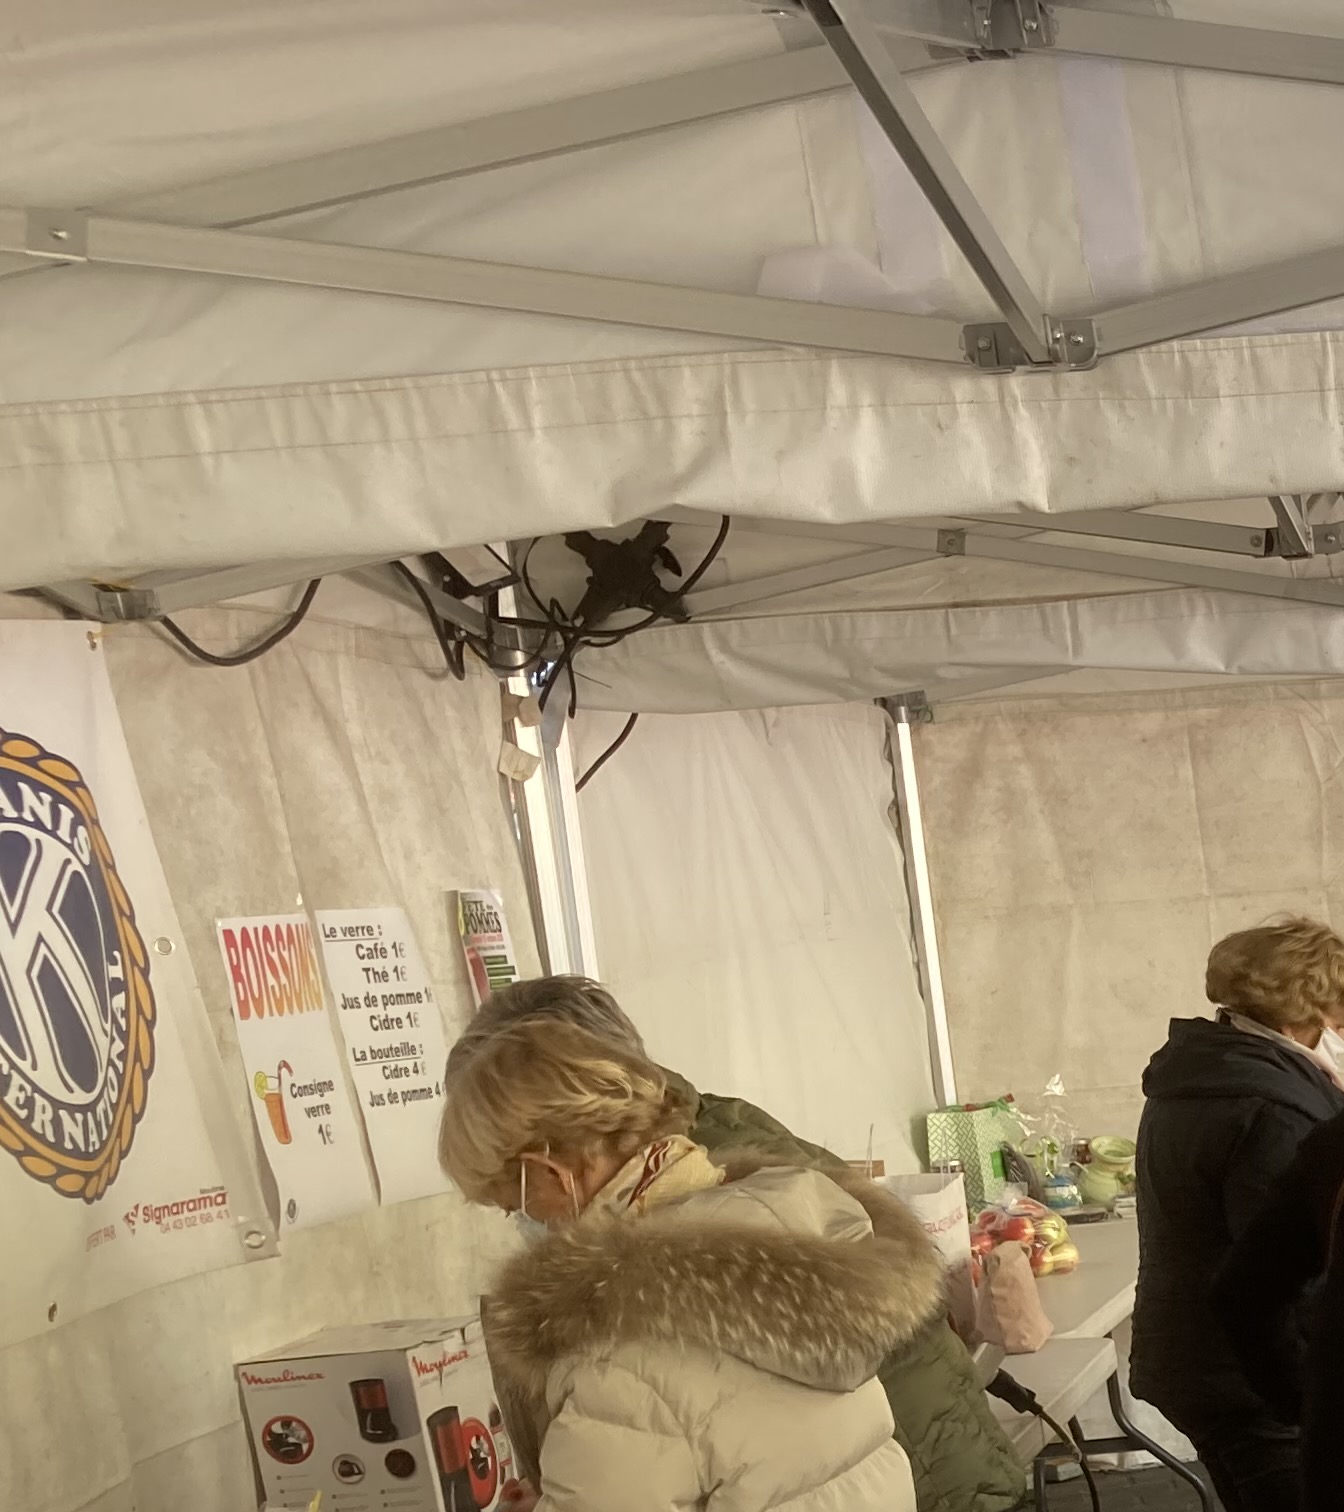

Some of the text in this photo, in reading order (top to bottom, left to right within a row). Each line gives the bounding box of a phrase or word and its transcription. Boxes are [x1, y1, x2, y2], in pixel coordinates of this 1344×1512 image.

[322, 923, 337, 939] Le
[340, 924, 374, 938] verre
[356, 941, 406, 961] Café 1€
[222, 922, 323, 1021] BOISSONS
[362, 965, 408, 984] Thé 1€
[341, 992, 361, 1010] Jus
[364, 991, 379, 1008] de
[382, 991, 423, 1012] pomme
[369, 1011, 420, 1031] Cidre 1€
[352, 1046, 367, 1062] La
[370, 1042, 417, 1060] bouteille
[381, 1063, 410, 1080] Cidre
[412, 1061, 419, 1076] 4
[290, 1079, 335, 1099] Consigne
[368, 1090, 385, 1107] Jus
[387, 1089, 399, 1104] de
[401, 1085, 434, 1107] pomme
[435, 1081, 442, 1097] 4
[304, 1103, 332, 1119] verre
[318, 1123, 334, 1145] 1€
[142, 1191, 228, 1225] Signarama
[185, 1215, 198, 1228] 02
[411, 1350, 471, 1378] Moulinex
[241, 1369, 326, 1386] Moulinex
